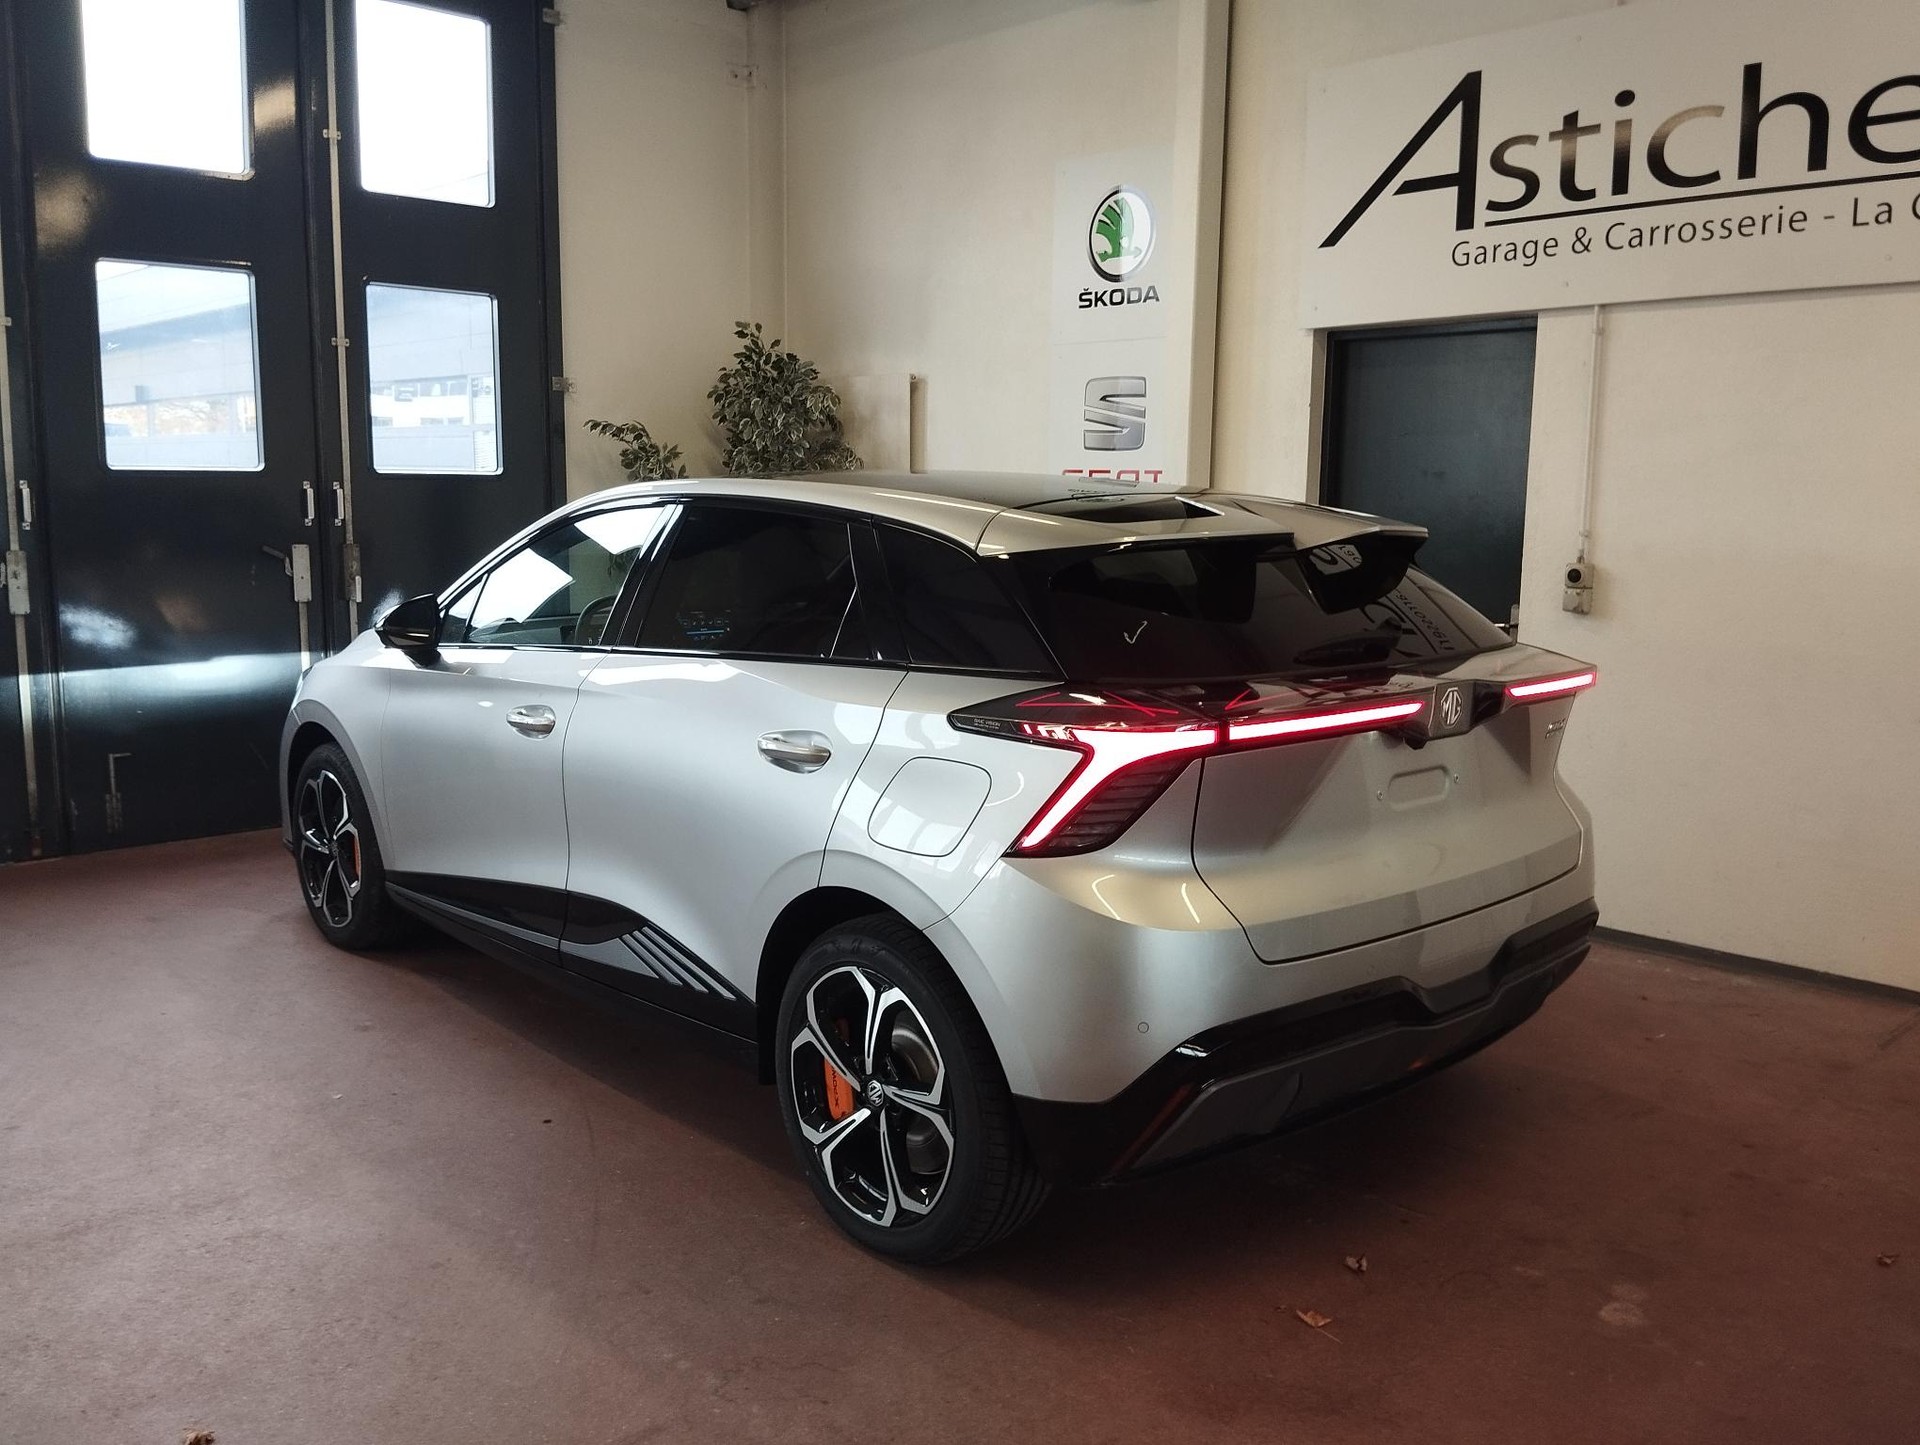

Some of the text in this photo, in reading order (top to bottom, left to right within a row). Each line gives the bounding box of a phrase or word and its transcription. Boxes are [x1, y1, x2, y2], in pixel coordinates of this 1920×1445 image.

[1451, 236, 1559, 268] Garage
[1571, 226, 1593, 255] &
[1604, 205, 1808, 251] Carrosserie
[1852, 196, 1893, 227] La
[1078, 285, 1160, 309] ŠKODA
[1440, 687, 1463, 729] MG
